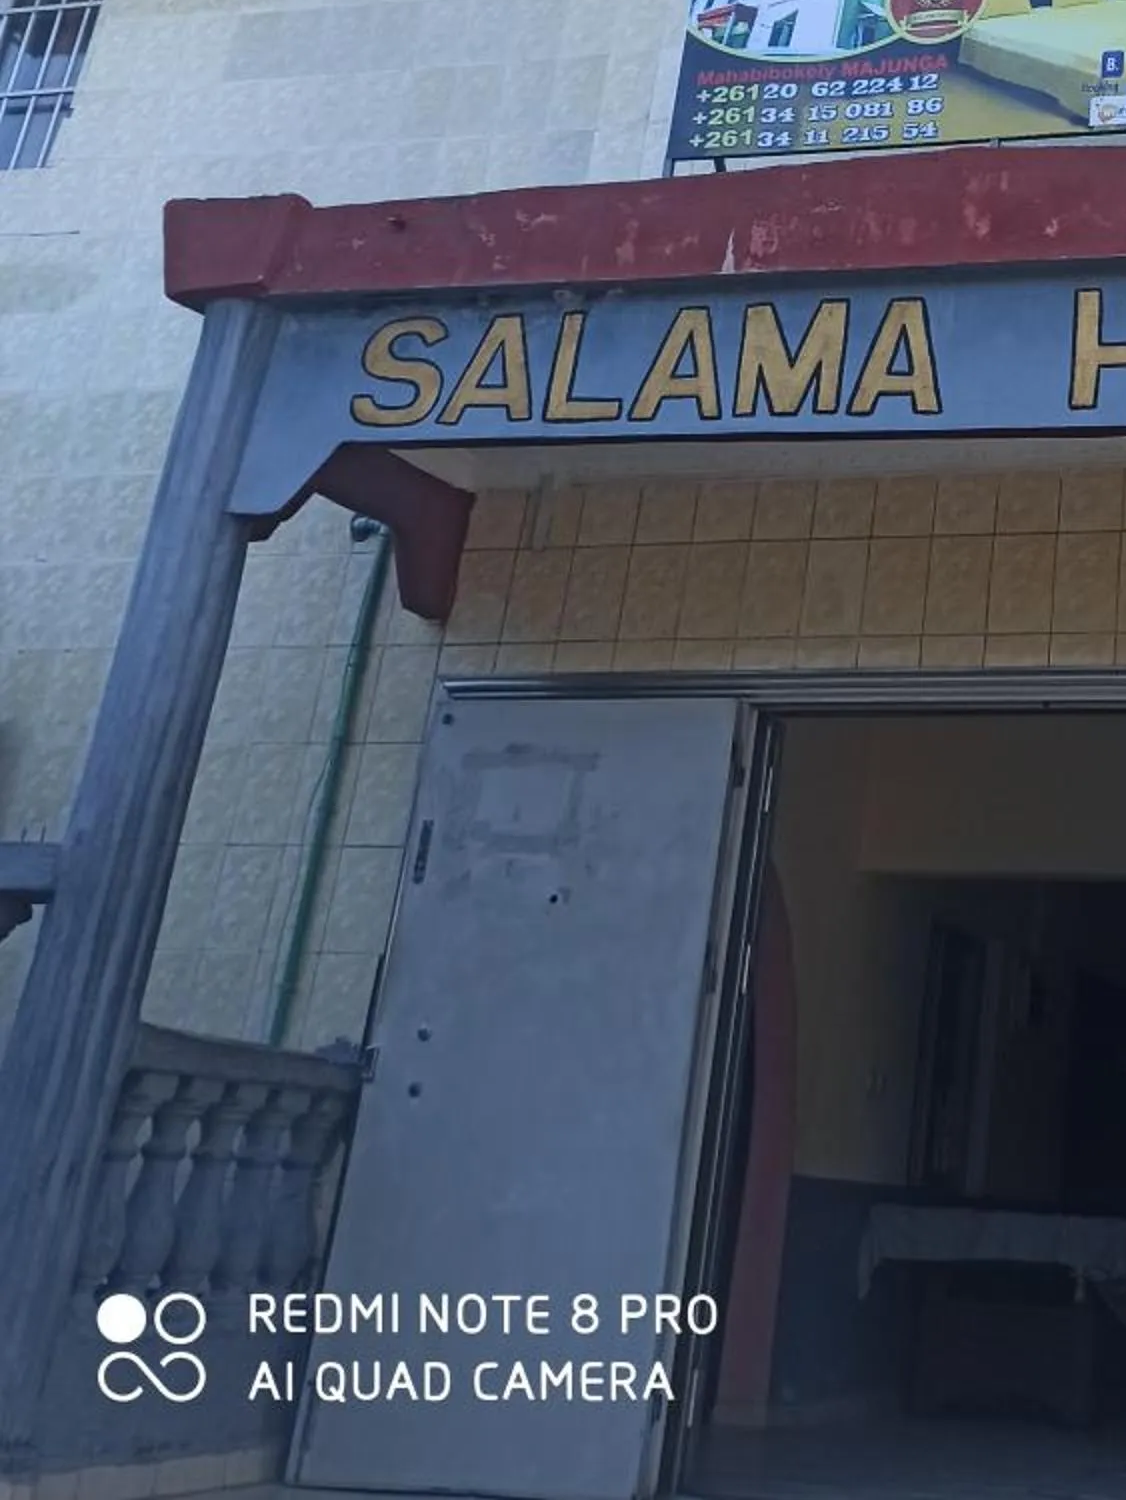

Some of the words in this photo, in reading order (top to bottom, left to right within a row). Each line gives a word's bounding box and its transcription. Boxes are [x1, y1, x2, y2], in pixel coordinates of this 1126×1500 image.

[842, 55, 948, 77] MAJUNGA
[811, 81, 847, 97] 62
[851, 77, 903, 96] 224
[909, 74, 939, 91] 12
[807, 104, 838, 122] 15
[845, 101, 894, 120] 081
[803, 128, 829, 146] 11
[842, 124, 890, 142] 215
[902, 122, 938, 140] 54
[350, 296, 943, 427] SALAMA
